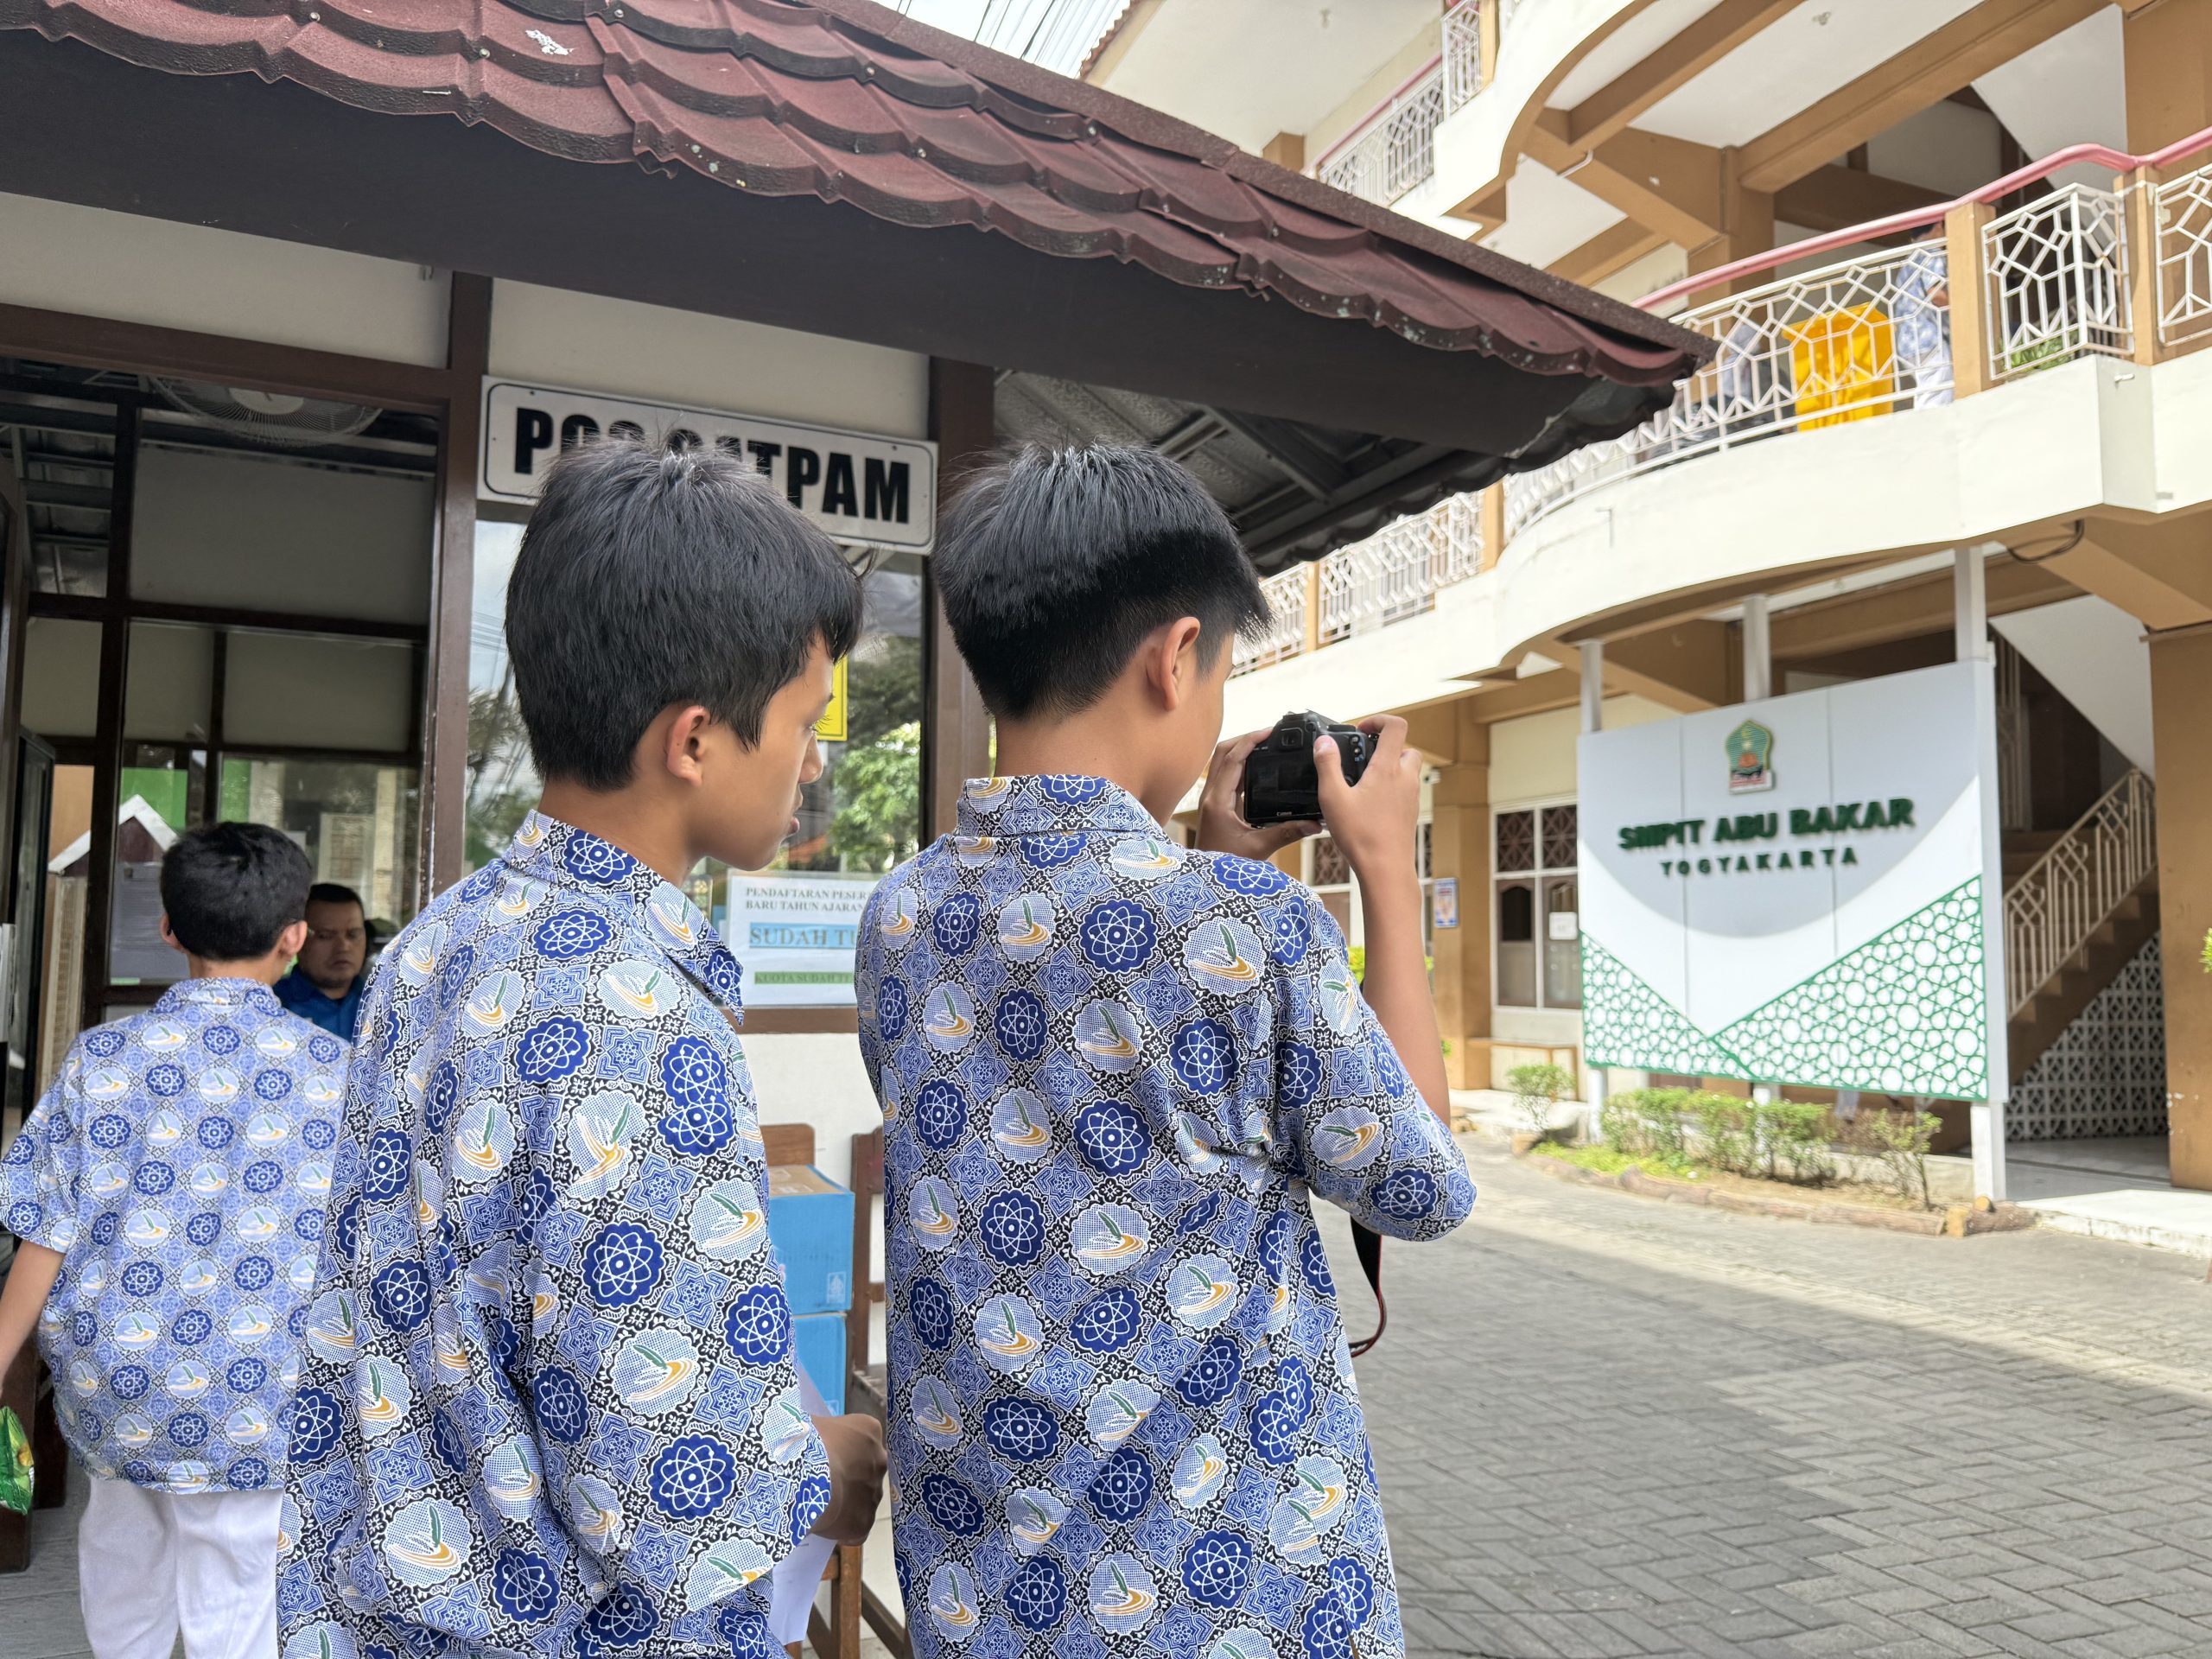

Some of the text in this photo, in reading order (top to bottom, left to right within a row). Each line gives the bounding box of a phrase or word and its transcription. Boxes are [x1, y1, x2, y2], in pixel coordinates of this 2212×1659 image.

[1713, 812, 1778, 842] ABU
[1789, 798, 1916, 835] BAKAR
[1661, 848, 1857, 876] YOGYAKARTA
[746, 887, 830, 899] PENDAFTARAN
[746, 899, 775, 910] BARU
[781, 900, 820, 912] TAHUN
[749, 925, 829, 945] SUDAH
[755, 973, 795, 983] KUOTA
[797, 974, 836, 983] SUDAH
